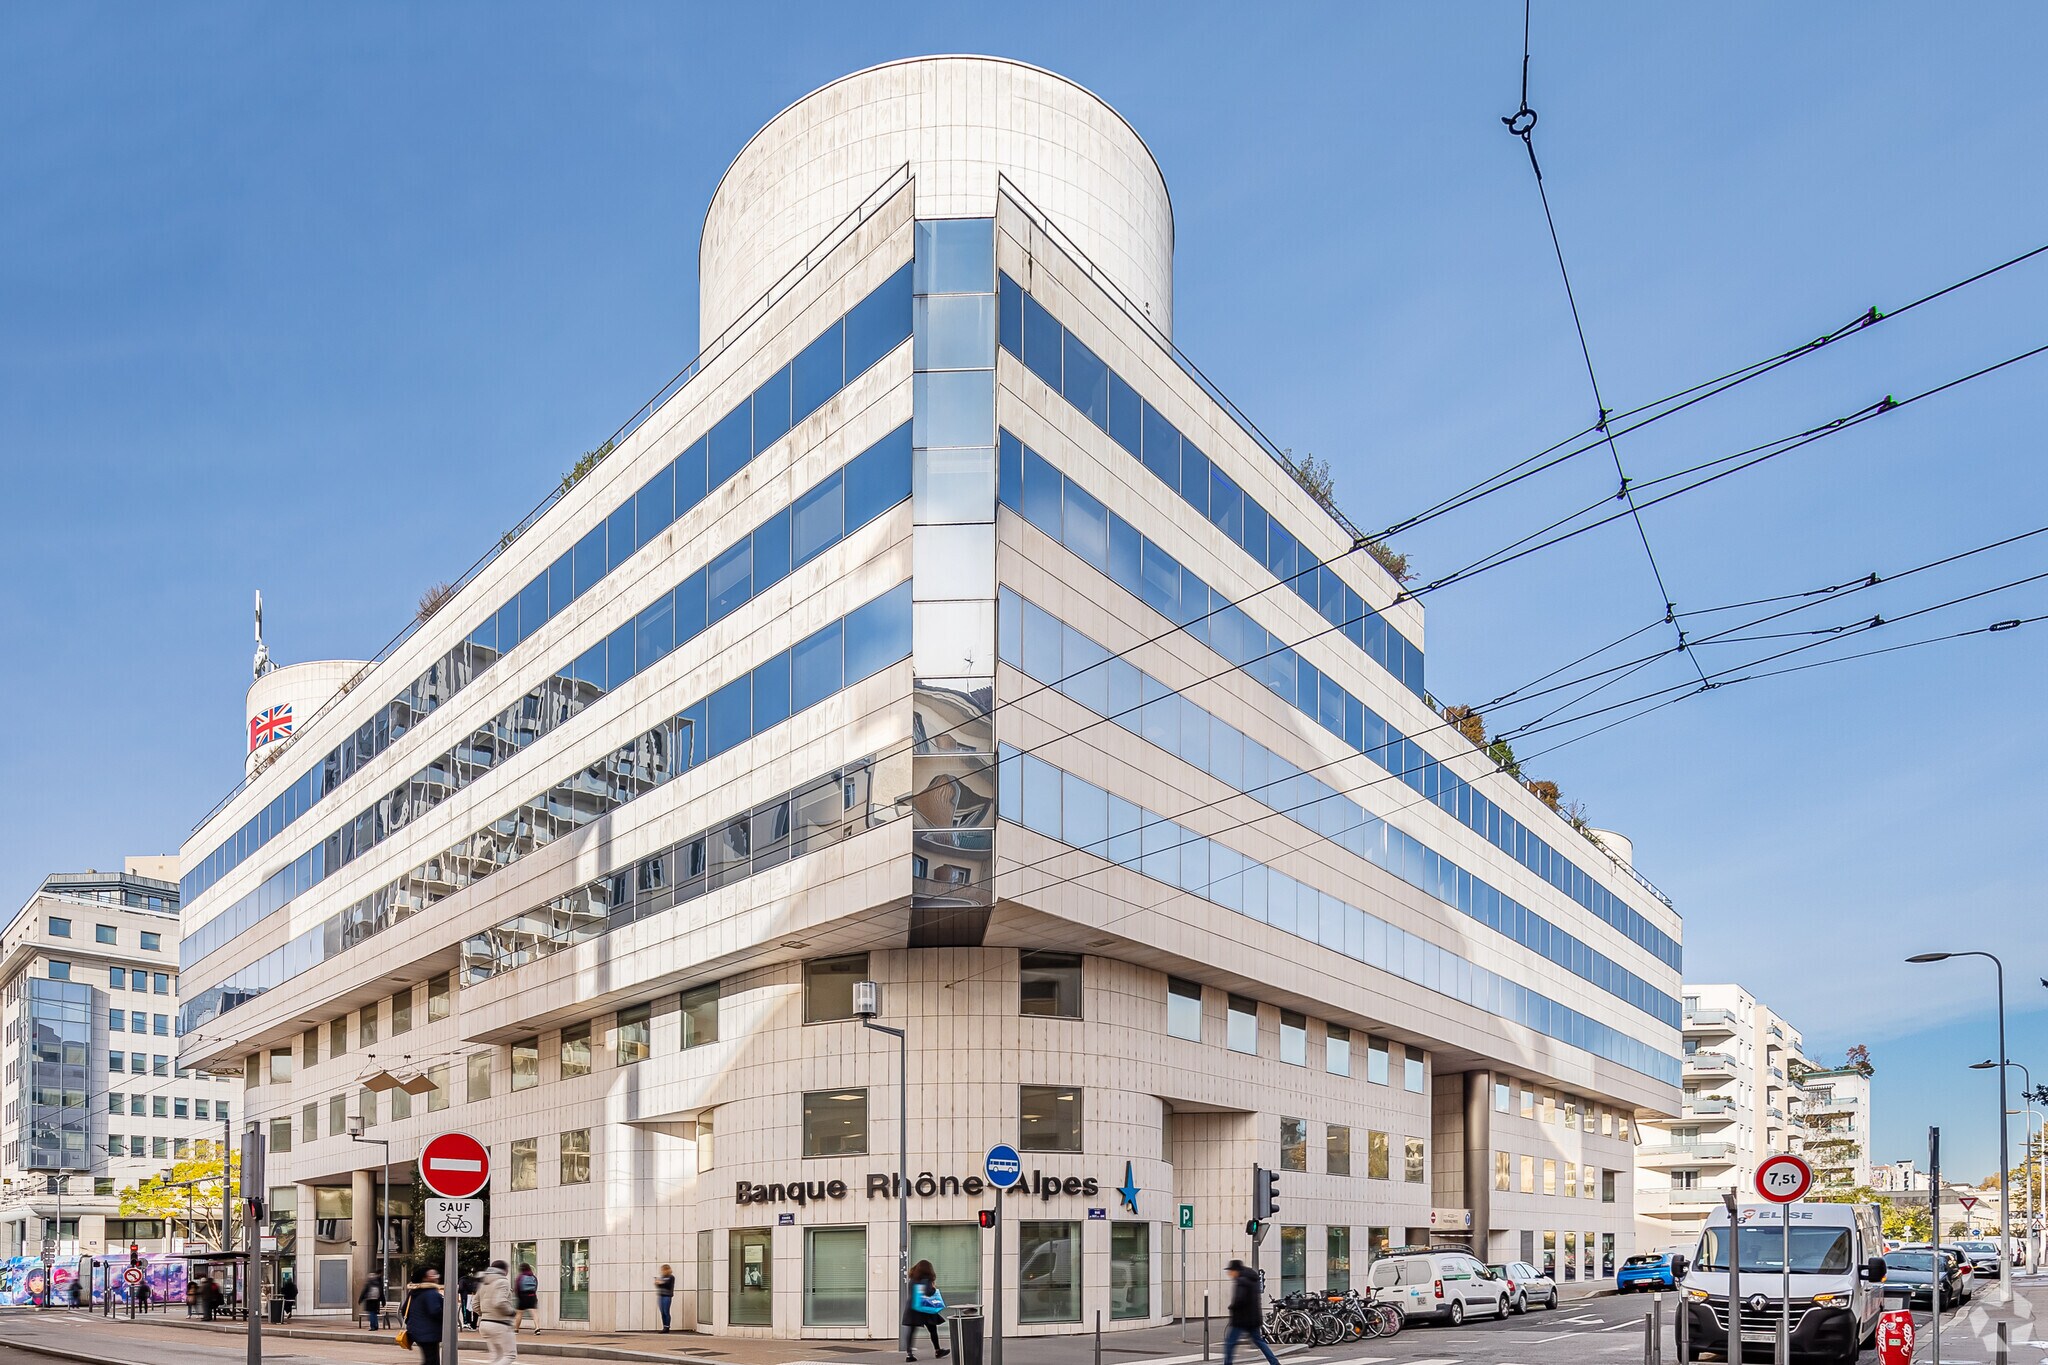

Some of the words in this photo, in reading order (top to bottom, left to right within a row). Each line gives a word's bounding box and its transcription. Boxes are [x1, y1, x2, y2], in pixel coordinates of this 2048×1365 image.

[1769, 1172, 1797, 1186] 7,5t
[736, 1180, 847, 1206] Banque
[439, 1202, 471, 1212] SAUF
[1183, 1209, 1190, 1224] P
[1758, 1211, 1814, 1220] ELSE
